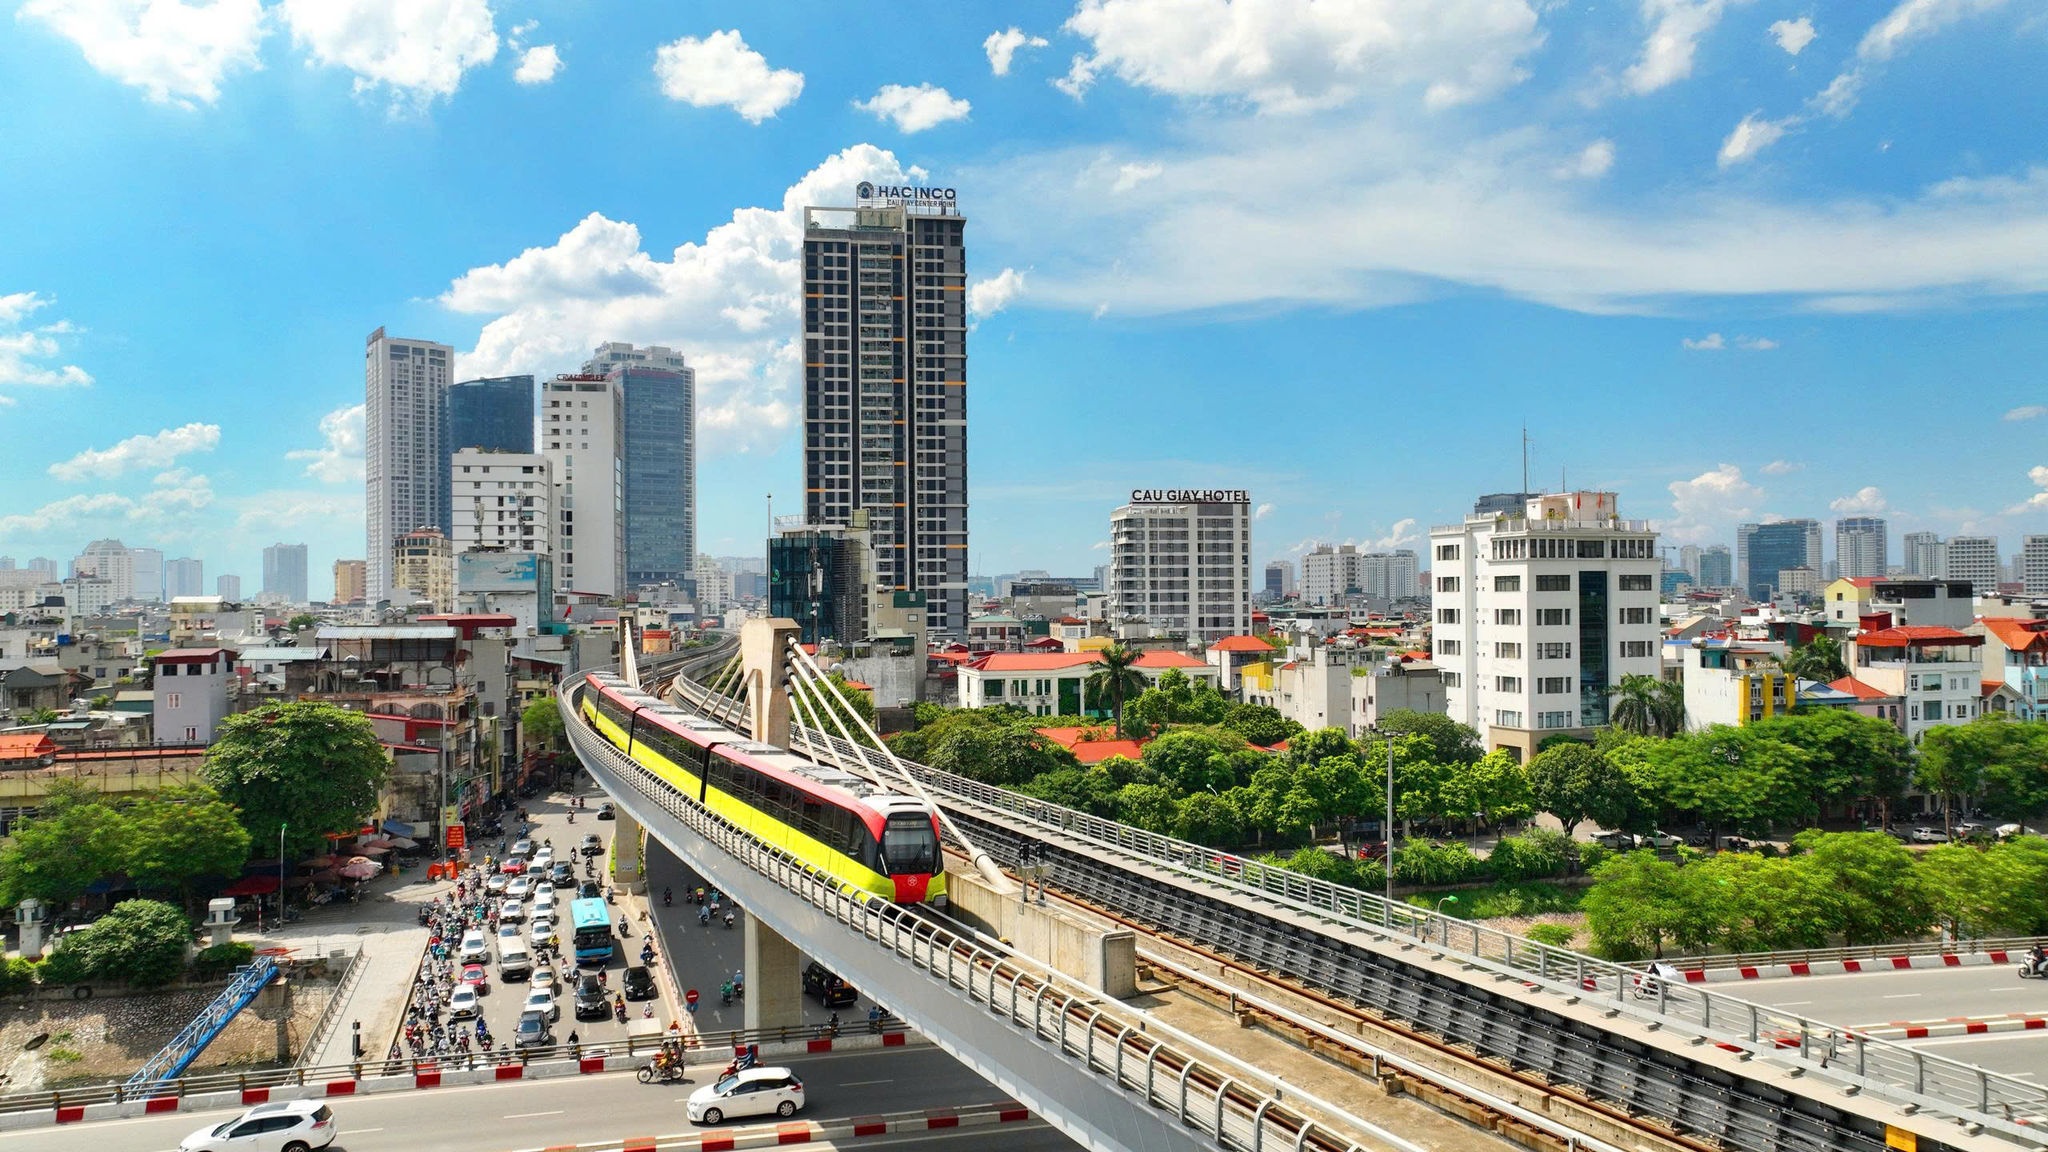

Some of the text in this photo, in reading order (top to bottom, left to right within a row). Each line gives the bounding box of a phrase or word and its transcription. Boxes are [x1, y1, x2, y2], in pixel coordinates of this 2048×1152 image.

[878, 186, 956, 199] HACINCO
[1132, 489, 1250, 501] CAU GIAY HOTEL
